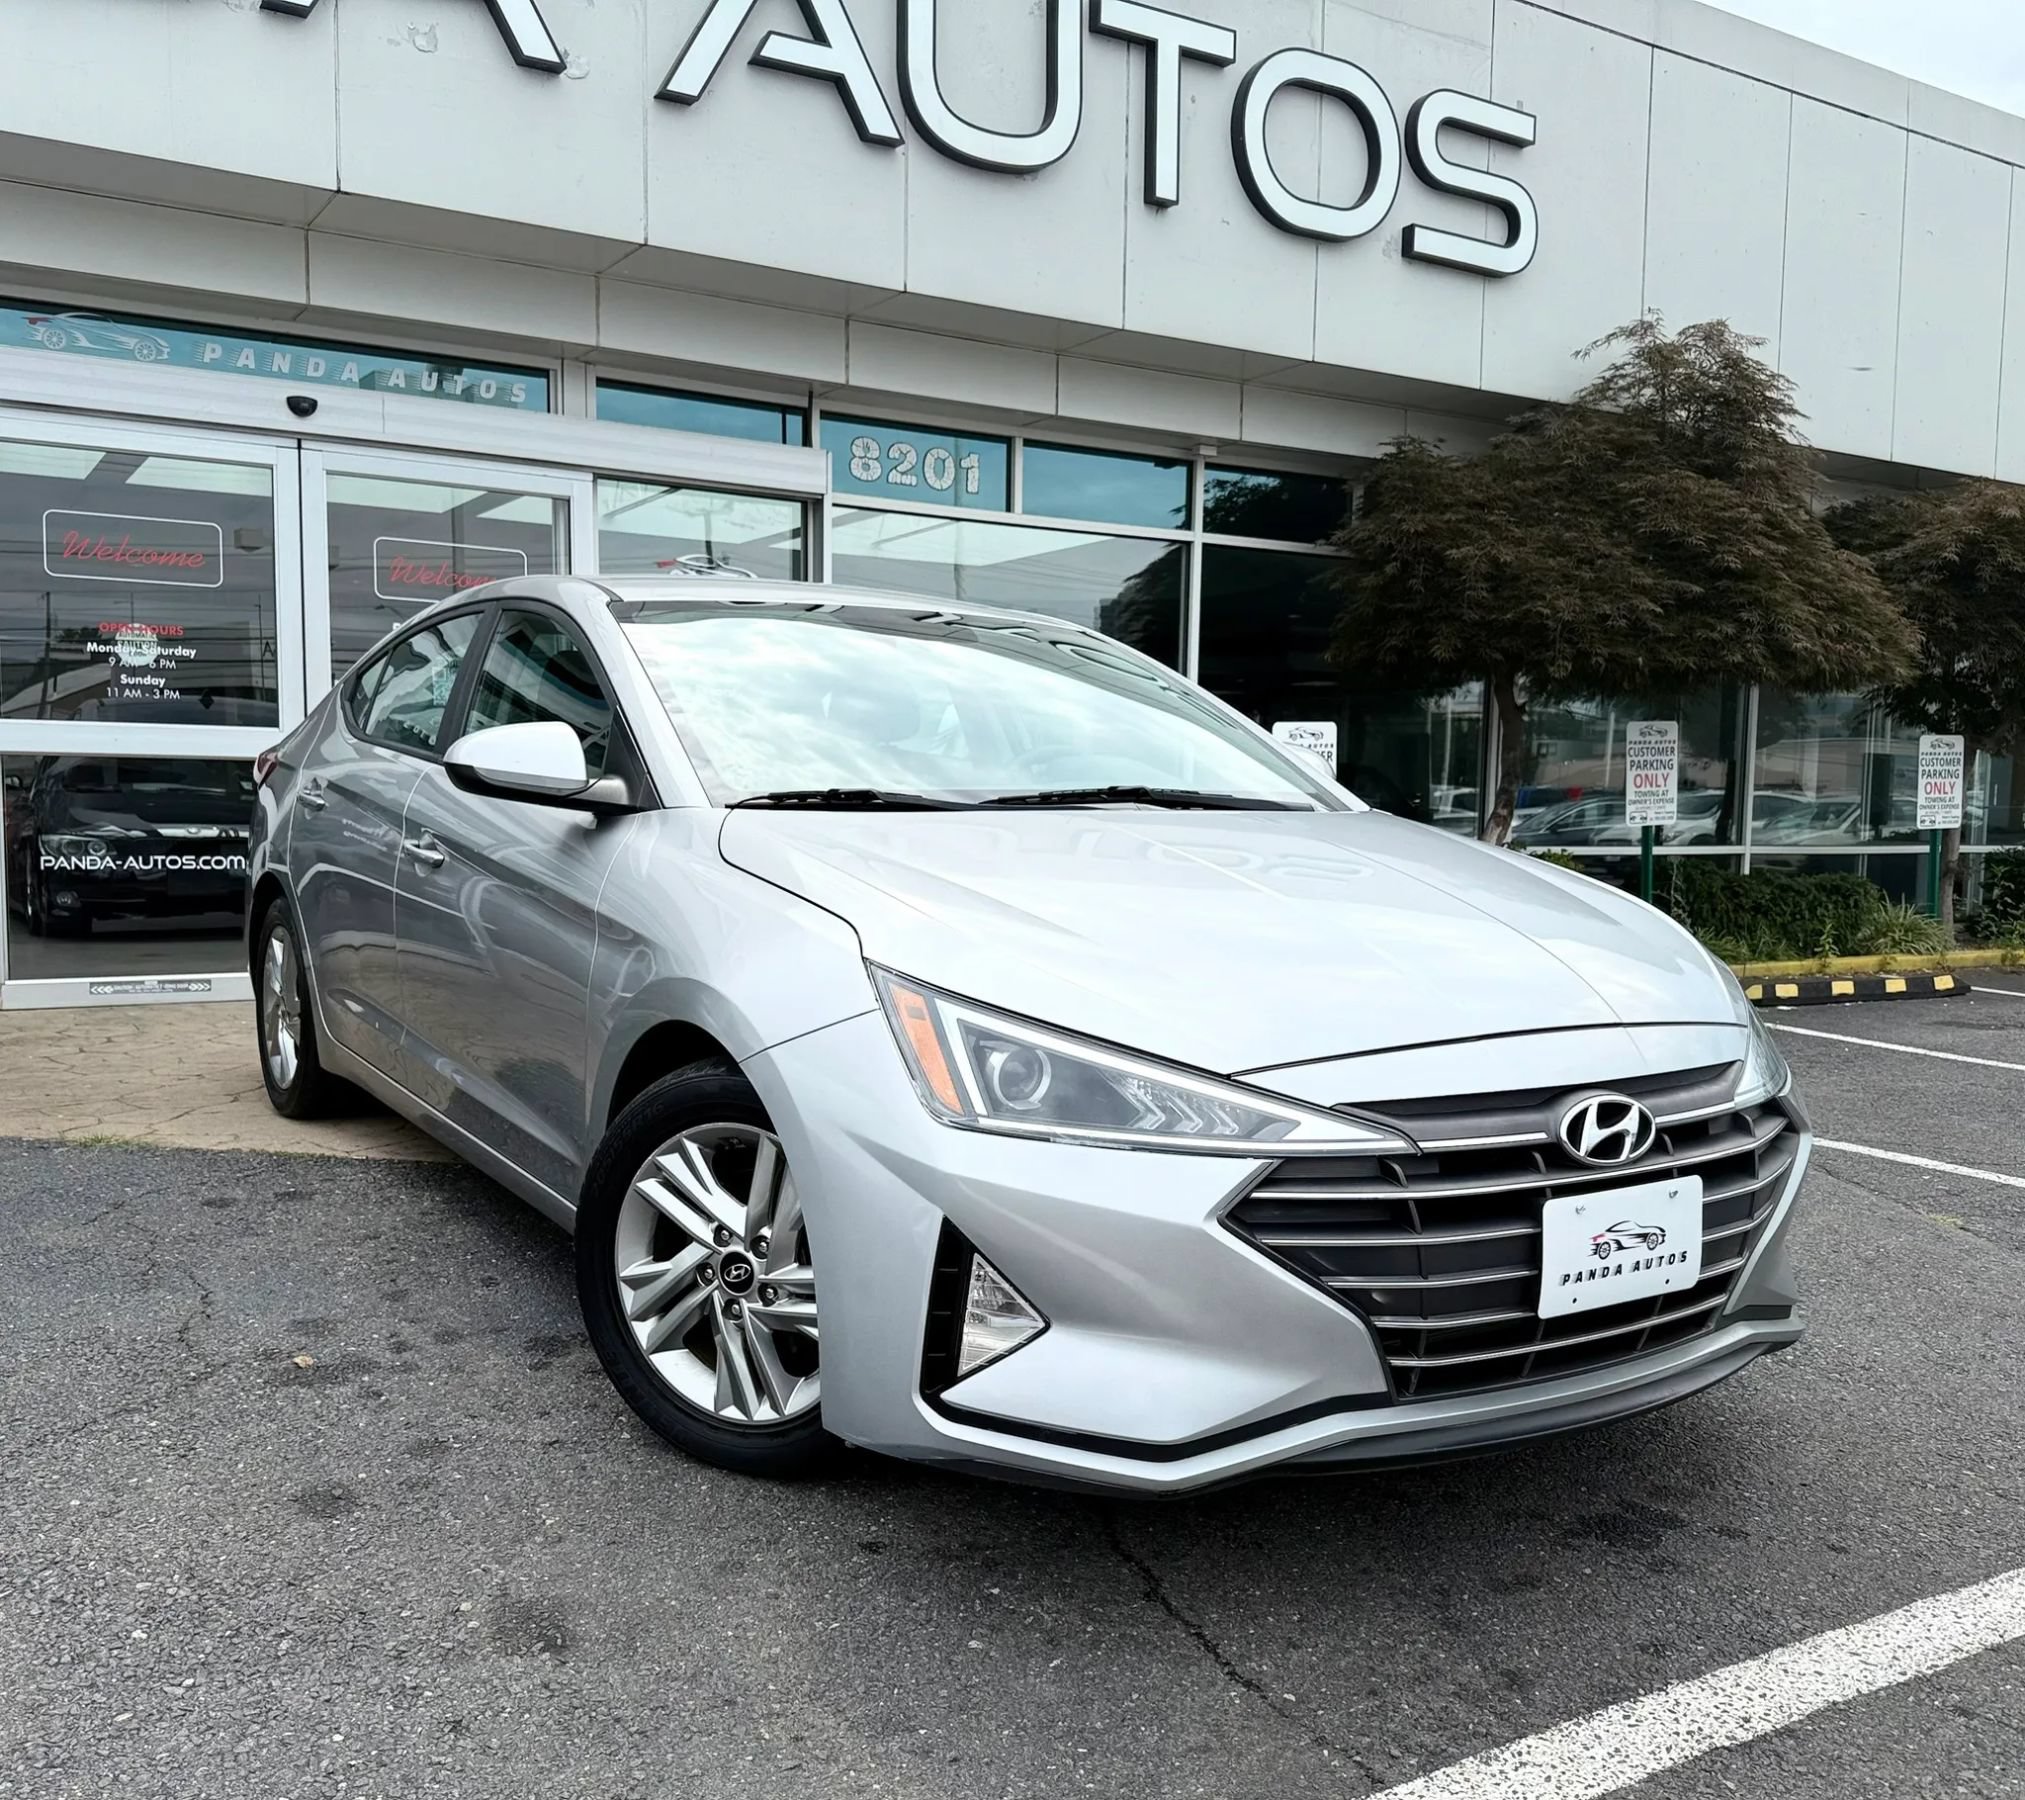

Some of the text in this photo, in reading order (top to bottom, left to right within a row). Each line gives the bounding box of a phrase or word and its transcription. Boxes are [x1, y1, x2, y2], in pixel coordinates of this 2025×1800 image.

[654, 0, 1540, 279] AUTOS
[200, 342, 527, 403] PANDA AUTOS
[849, 435, 980, 494] 8201
[63, 529, 206, 568] Welcome
[108, 657, 116, 668] 9
[160, 658, 177, 670] PM
[120, 673, 166, 688] Sunday
[106, 687, 119, 698] 11
[124, 688, 142, 699] AM
[153, 688, 160, 699] 3
[163, 688, 181, 700] PM
[1628, 746, 1676, 758] CUSTOMER
[1629, 758, 1674, 772] PARKING
[1920, 757, 1962, 768] CUSTOMER
[1633, 772, 1670, 789] ONLY
[1921, 768, 1960, 780] PARKING
[1660, 789, 1670, 797] AT
[1924, 781, 1957, 796] ONLY
[1560, 1250, 1688, 1286] PANDA AUTOS
